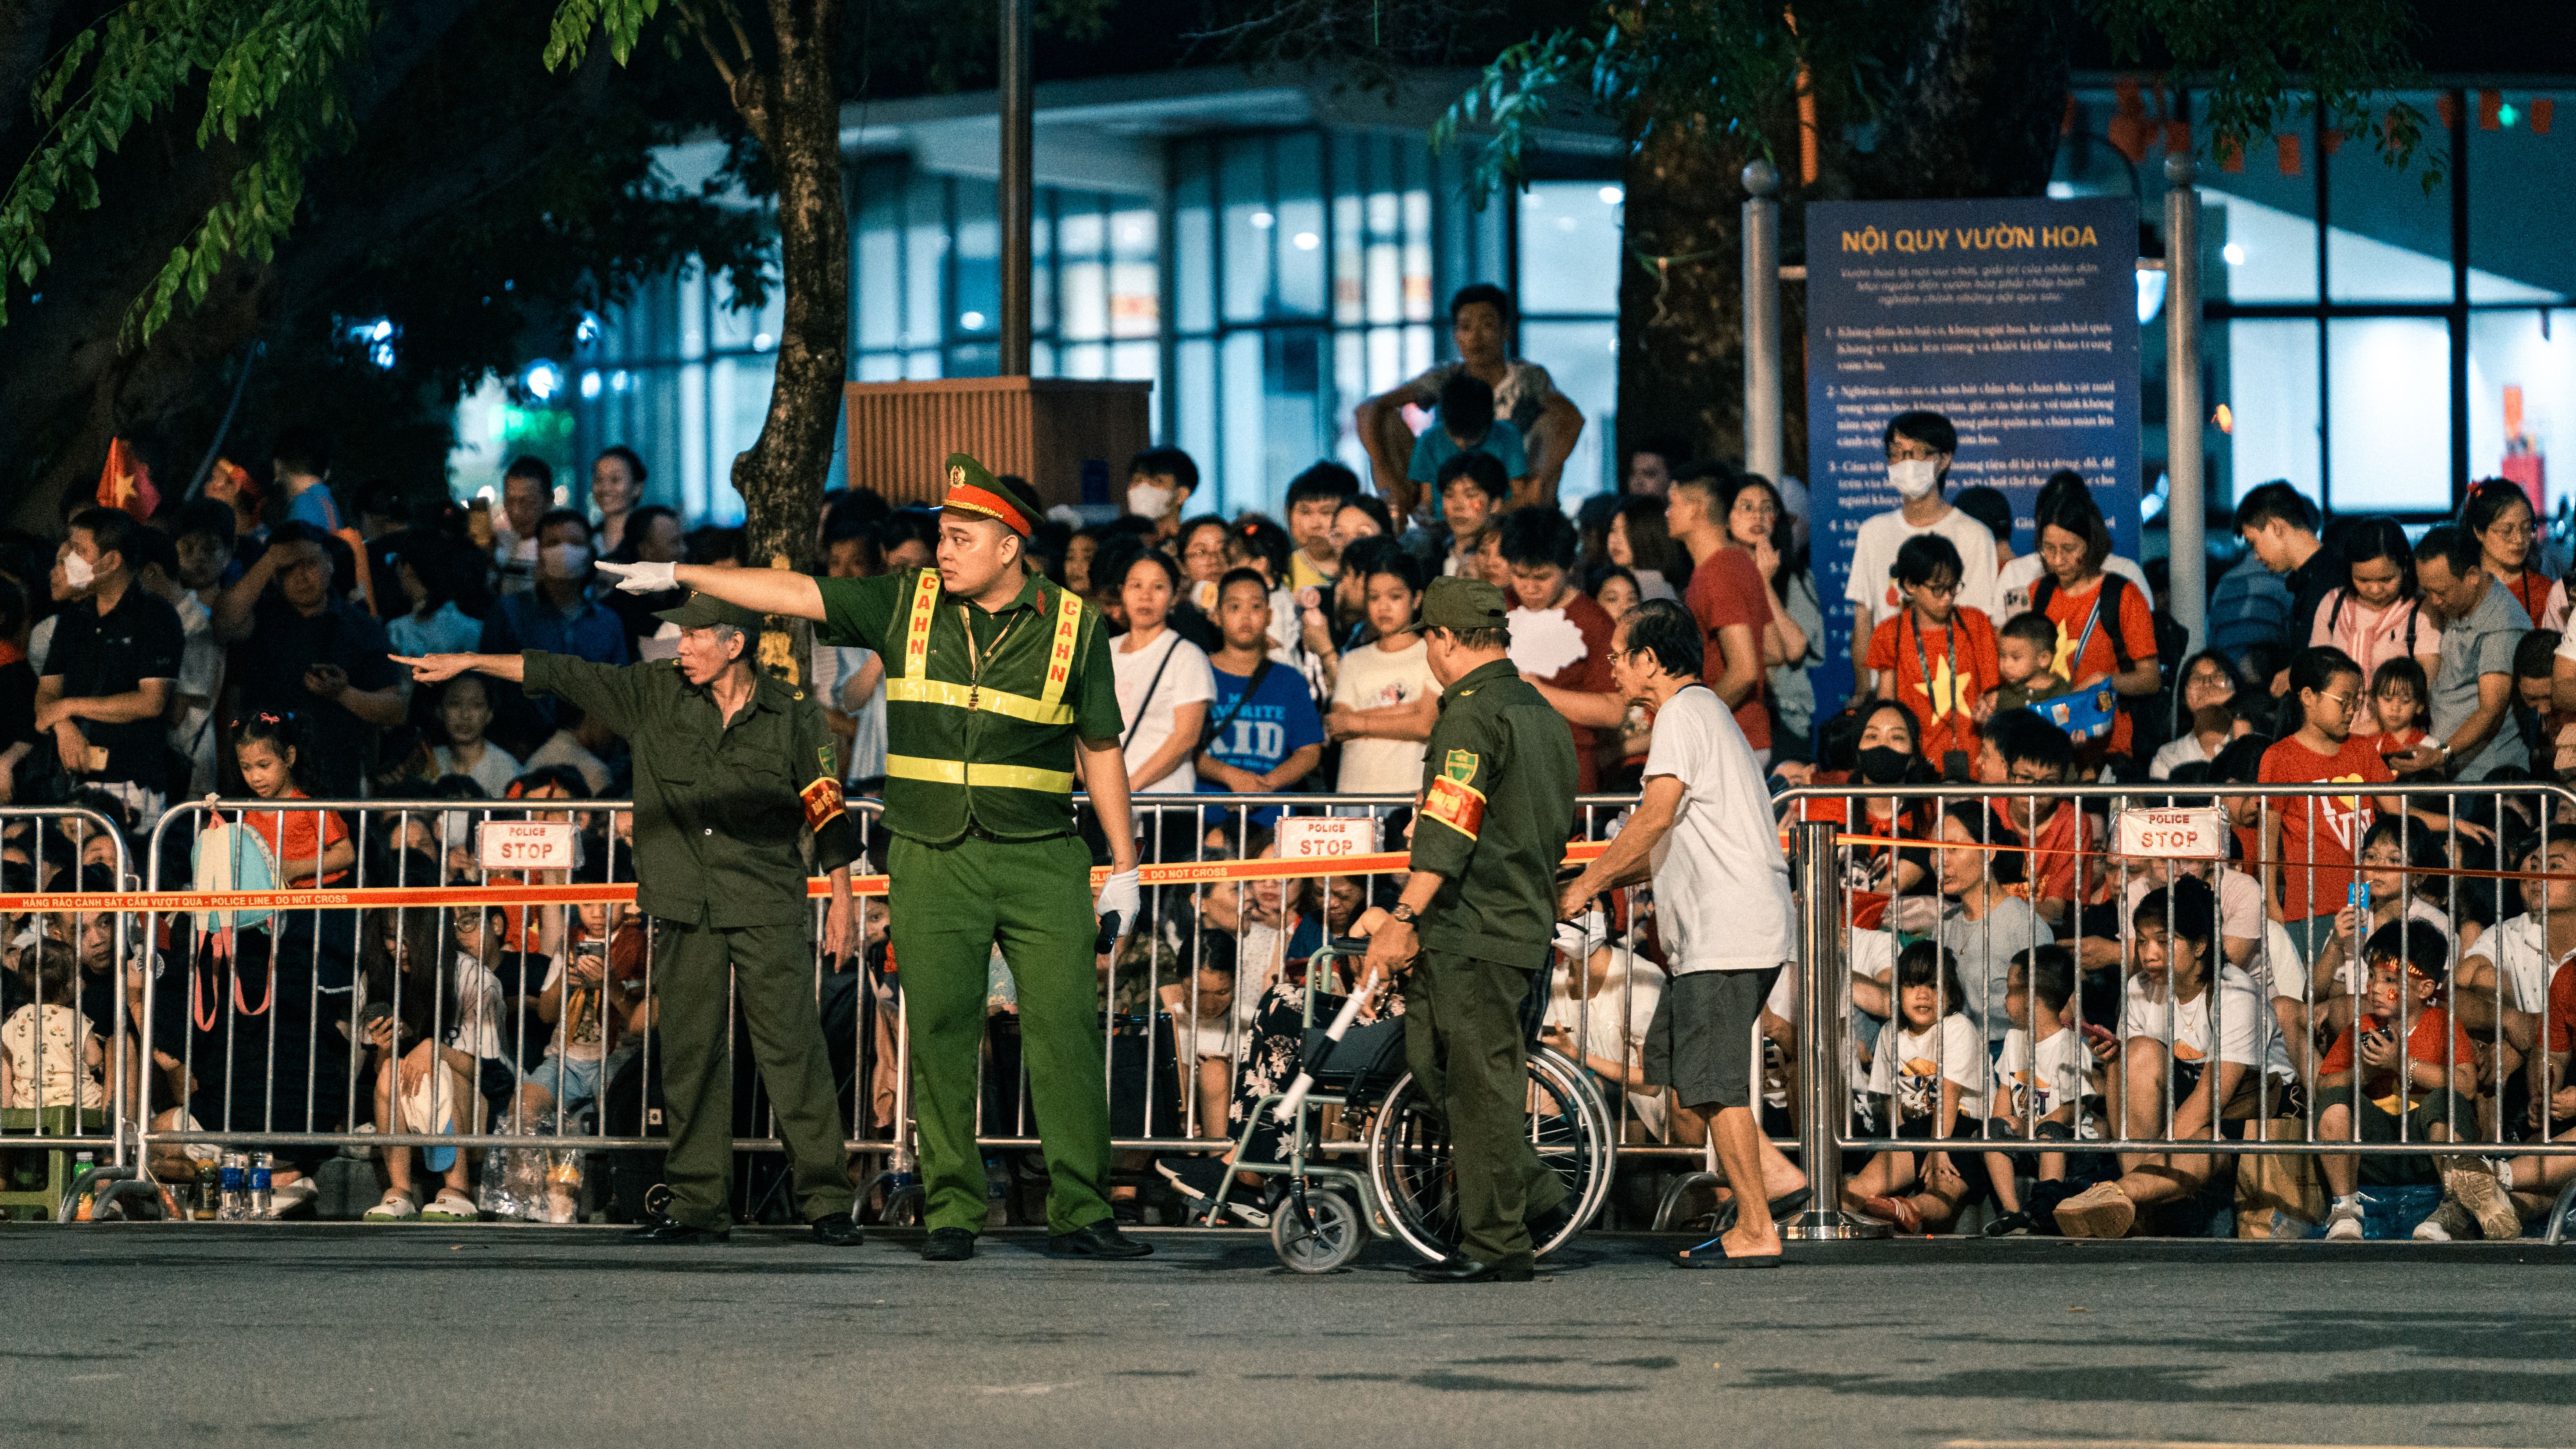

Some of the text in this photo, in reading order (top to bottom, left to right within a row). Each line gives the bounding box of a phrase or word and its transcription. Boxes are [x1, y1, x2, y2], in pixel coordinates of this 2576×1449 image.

[1842, 221, 2097, 255] NỘI QUY VƯỜN HOA
[910, 576, 936, 655] CAHN
[1050, 600, 1077, 683] CAHN
[2149, 814, 2190, 824] POLICE
[510, 828, 546, 836] POLICE
[1308, 823, 1345, 833] POLICE
[2142, 832, 2198, 847] STOP
[502, 843, 553, 858] STOP
[1301, 840, 1353, 855] STOP
[1168, 869, 1189, 878] NOT
[1192, 867, 1227, 876] CROSS
[127, 896, 148, 906] CẤM
[182, 897, 203, 906] QUA
[211, 896, 246, 906] POLICE
[249, 896, 273, 905] LINE.
[276, 896, 290, 904] DO
[292, 895, 311, 904] NOT
[314, 894, 348, 903] CROSS
